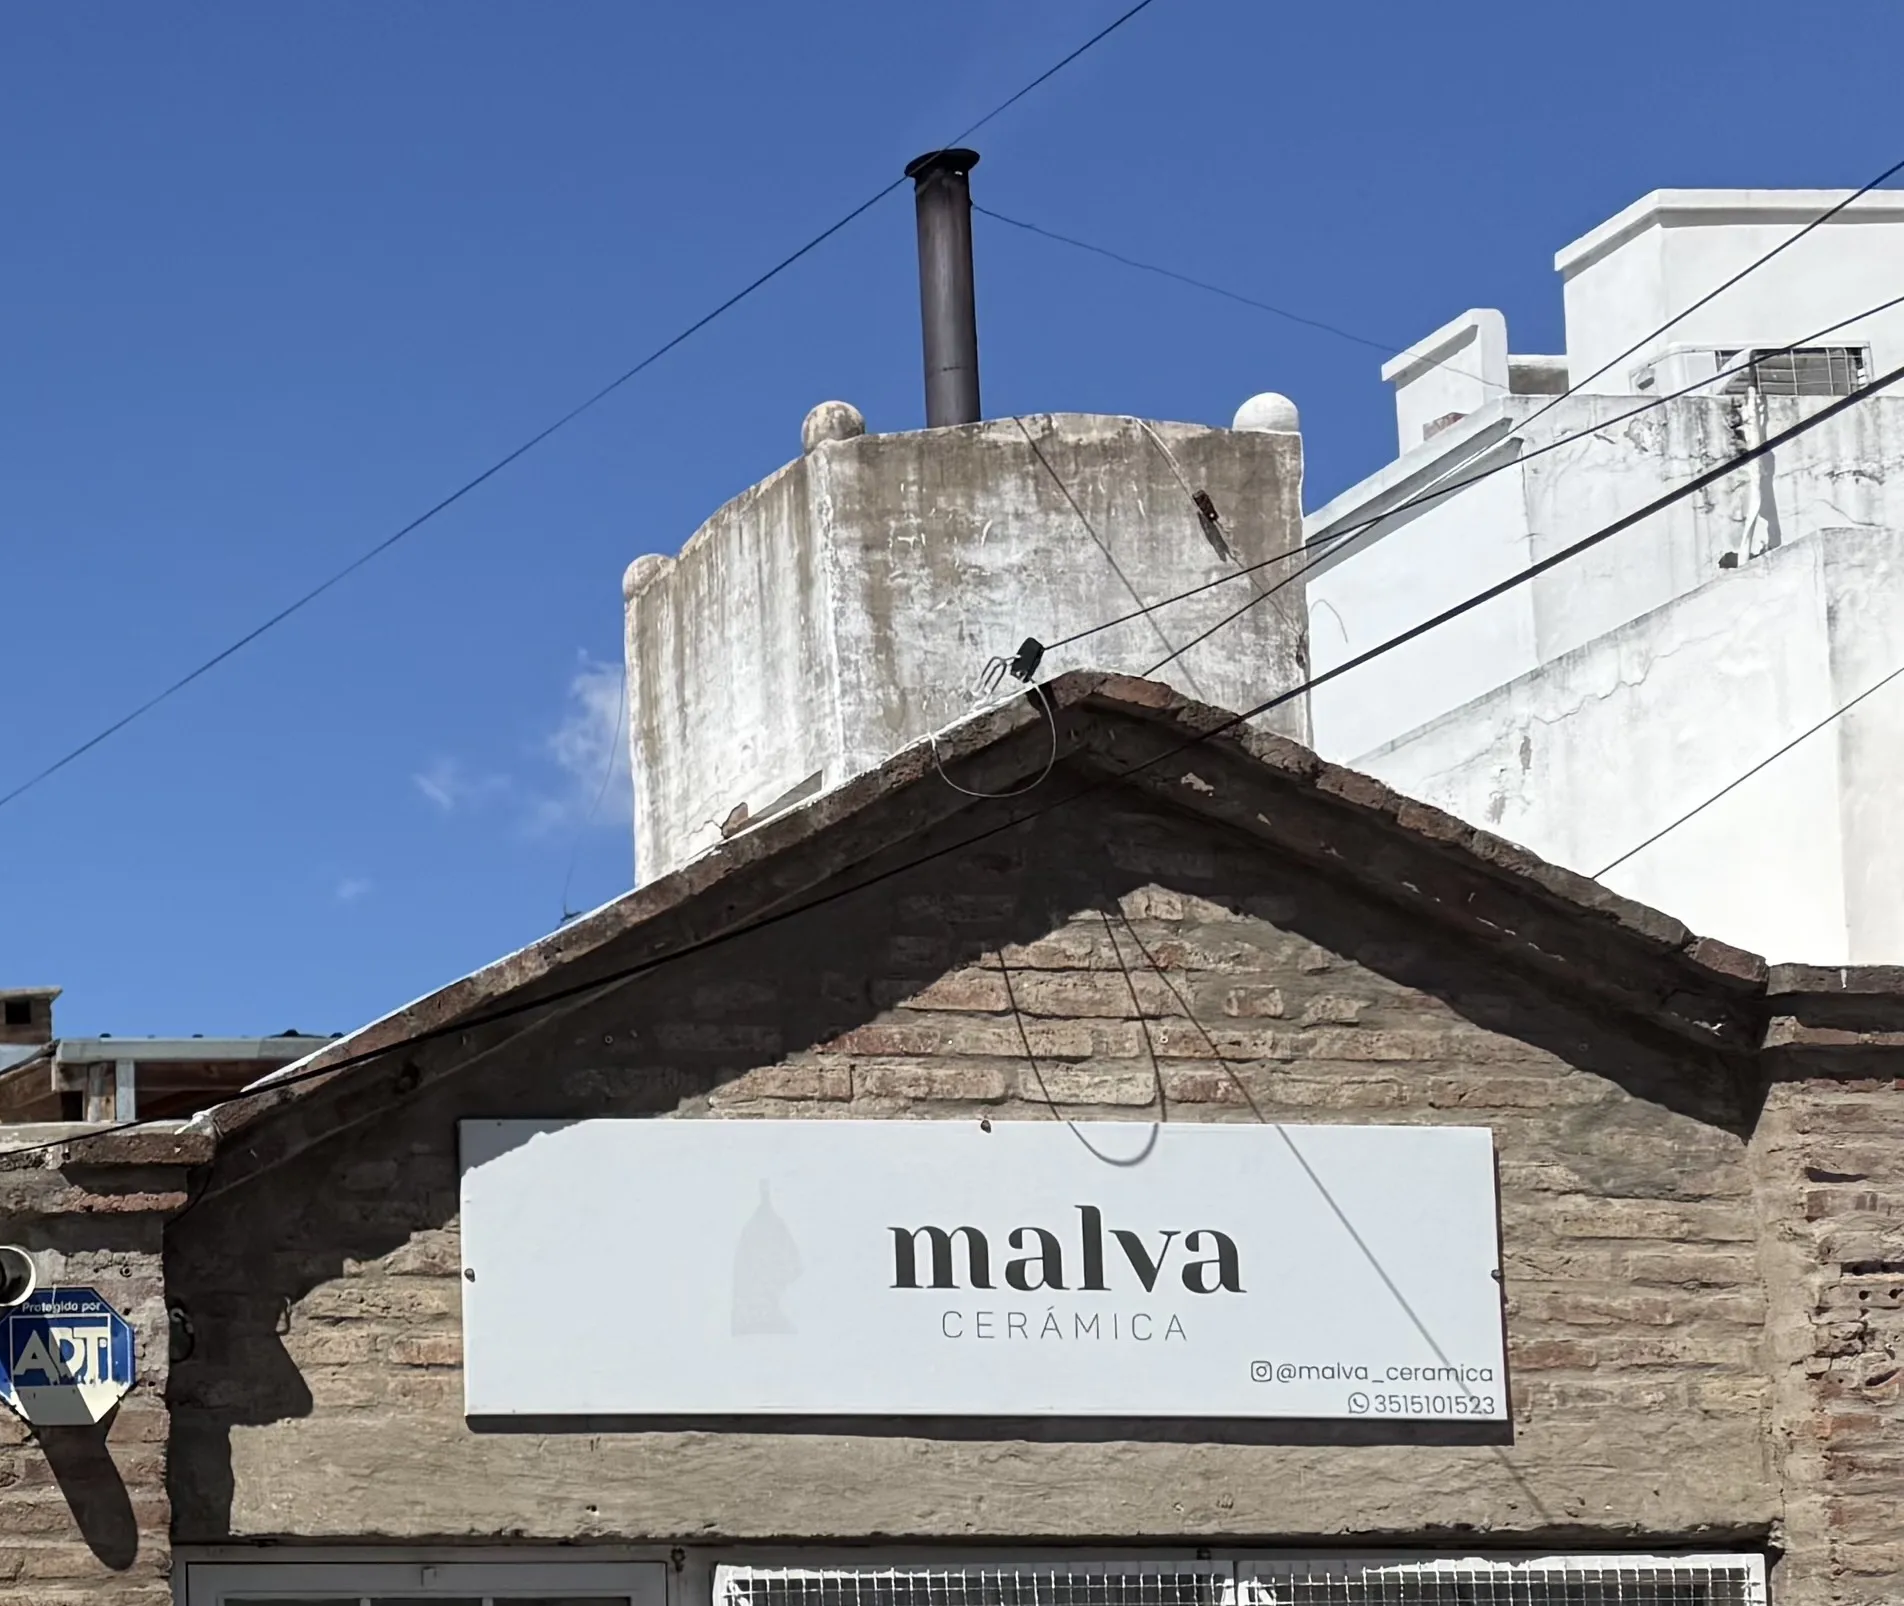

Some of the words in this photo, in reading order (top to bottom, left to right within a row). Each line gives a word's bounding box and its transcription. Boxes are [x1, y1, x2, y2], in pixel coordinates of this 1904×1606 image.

[887, 1204, 1247, 1294] malva
[22, 1301, 79, 1313] Protegido
[82, 1301, 101, 1313] por
[942, 1306, 1187, 1341] CERÁMICA
[13, 1327, 109, 1386] ADT
[1277, 1361, 1493, 1383] @malva_ceramica
[1374, 1394, 1495, 1415] 3515101523
